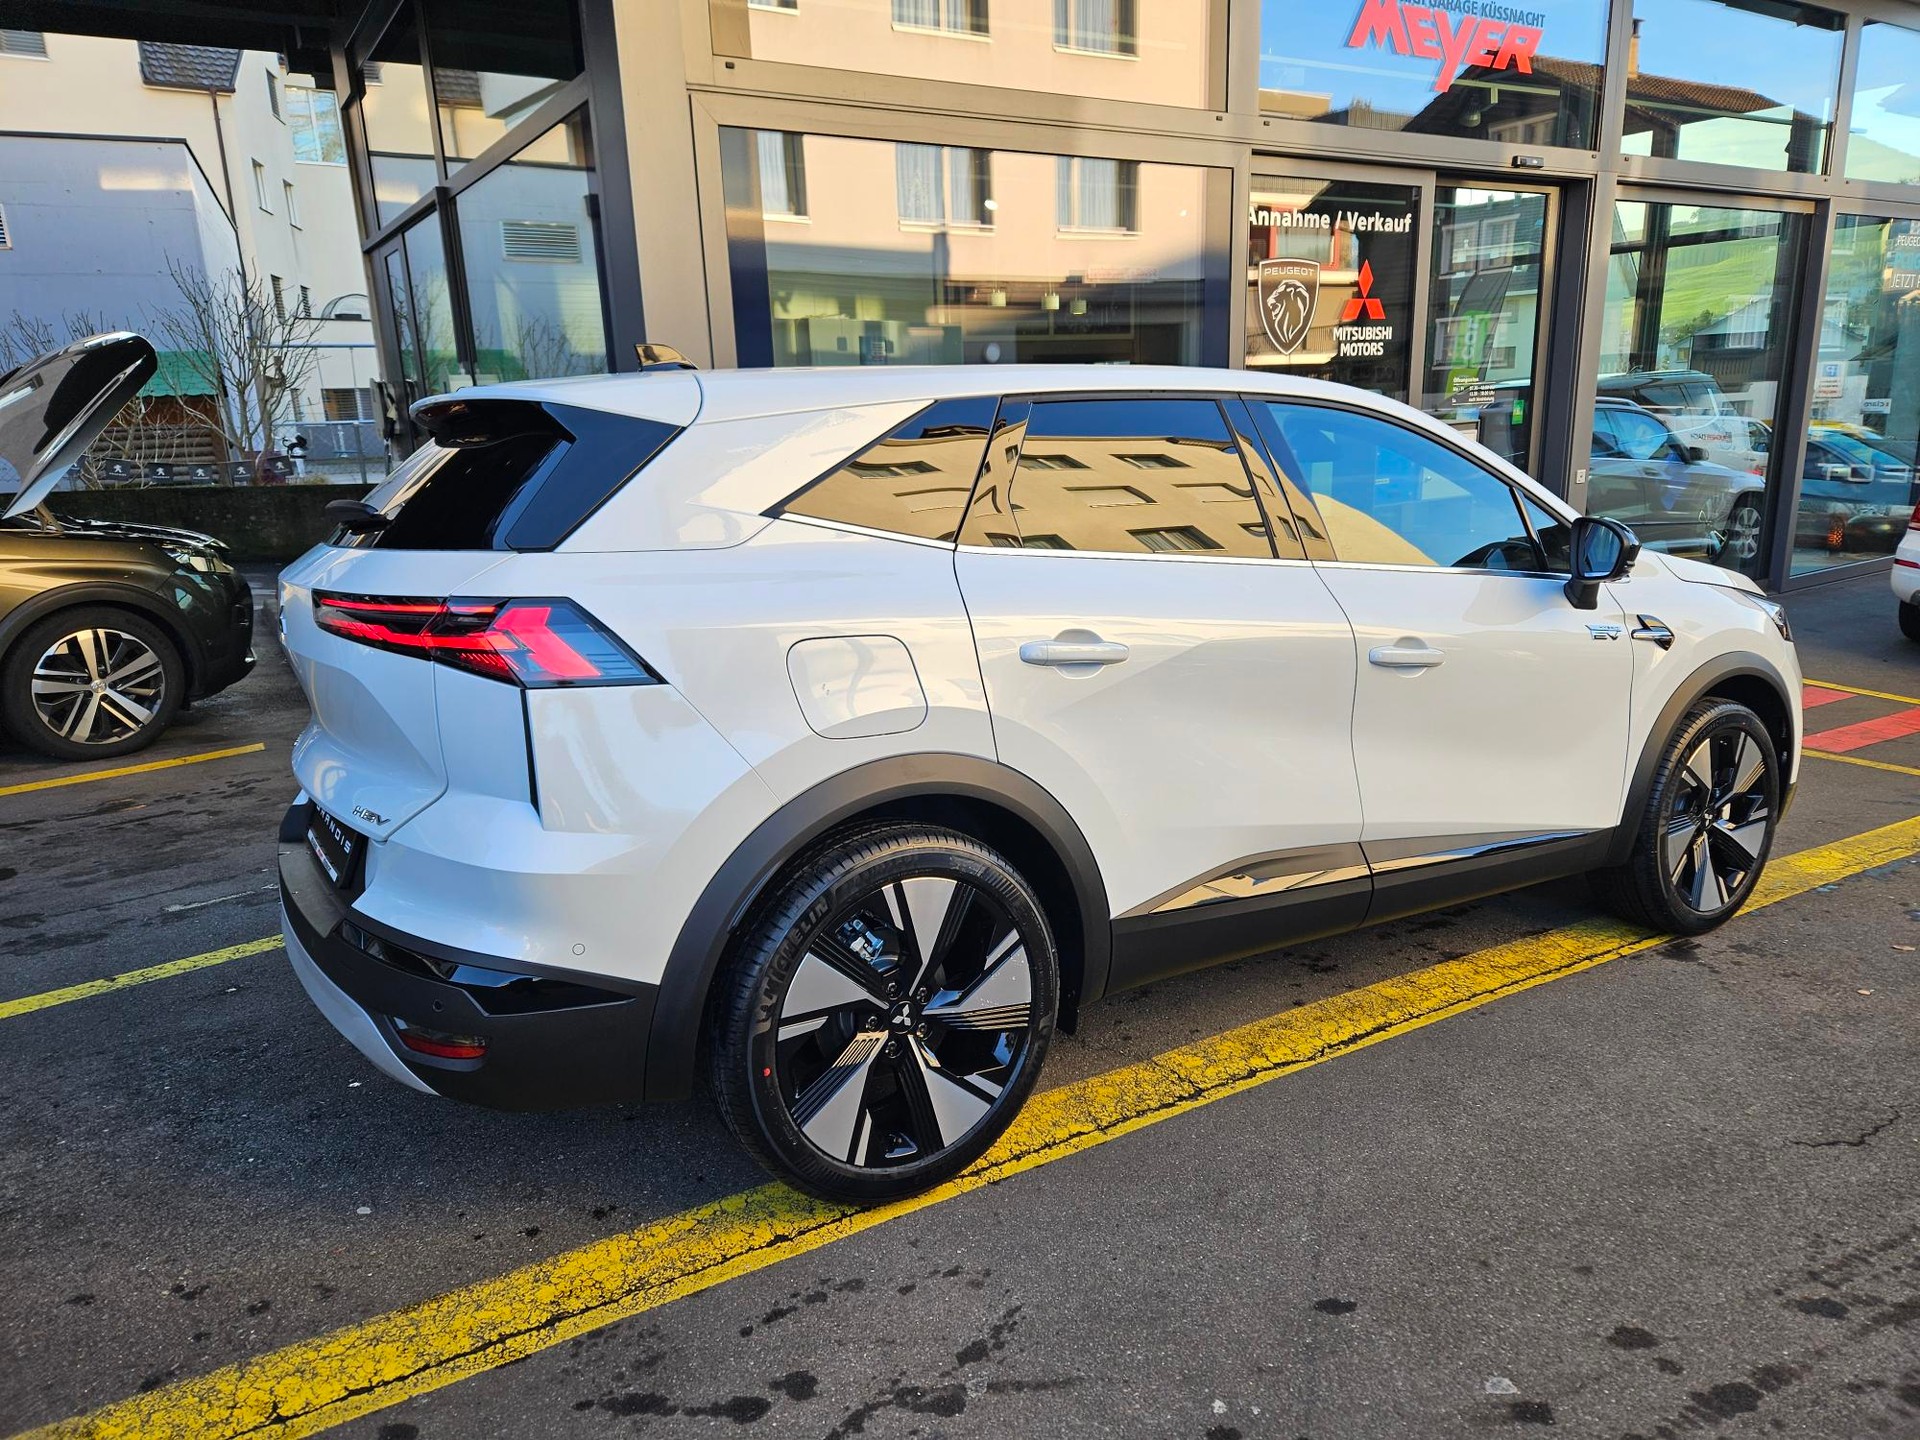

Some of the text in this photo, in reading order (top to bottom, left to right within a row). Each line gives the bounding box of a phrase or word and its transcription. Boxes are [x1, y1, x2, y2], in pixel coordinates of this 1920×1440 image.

[1480, 3, 1545, 28] KÜSSNACHT
[1347, 0, 1543, 92] MEYER
[1249, 207, 1330, 229] Annahme
[1347, 211, 1412, 233] Verkauf
[1264, 266, 1315, 277] PEUGEOT
[1333, 326, 1393, 341] MITSUBISHI
[1340, 342, 1384, 357] MOTORS
[352, 805, 391, 826] HEV
